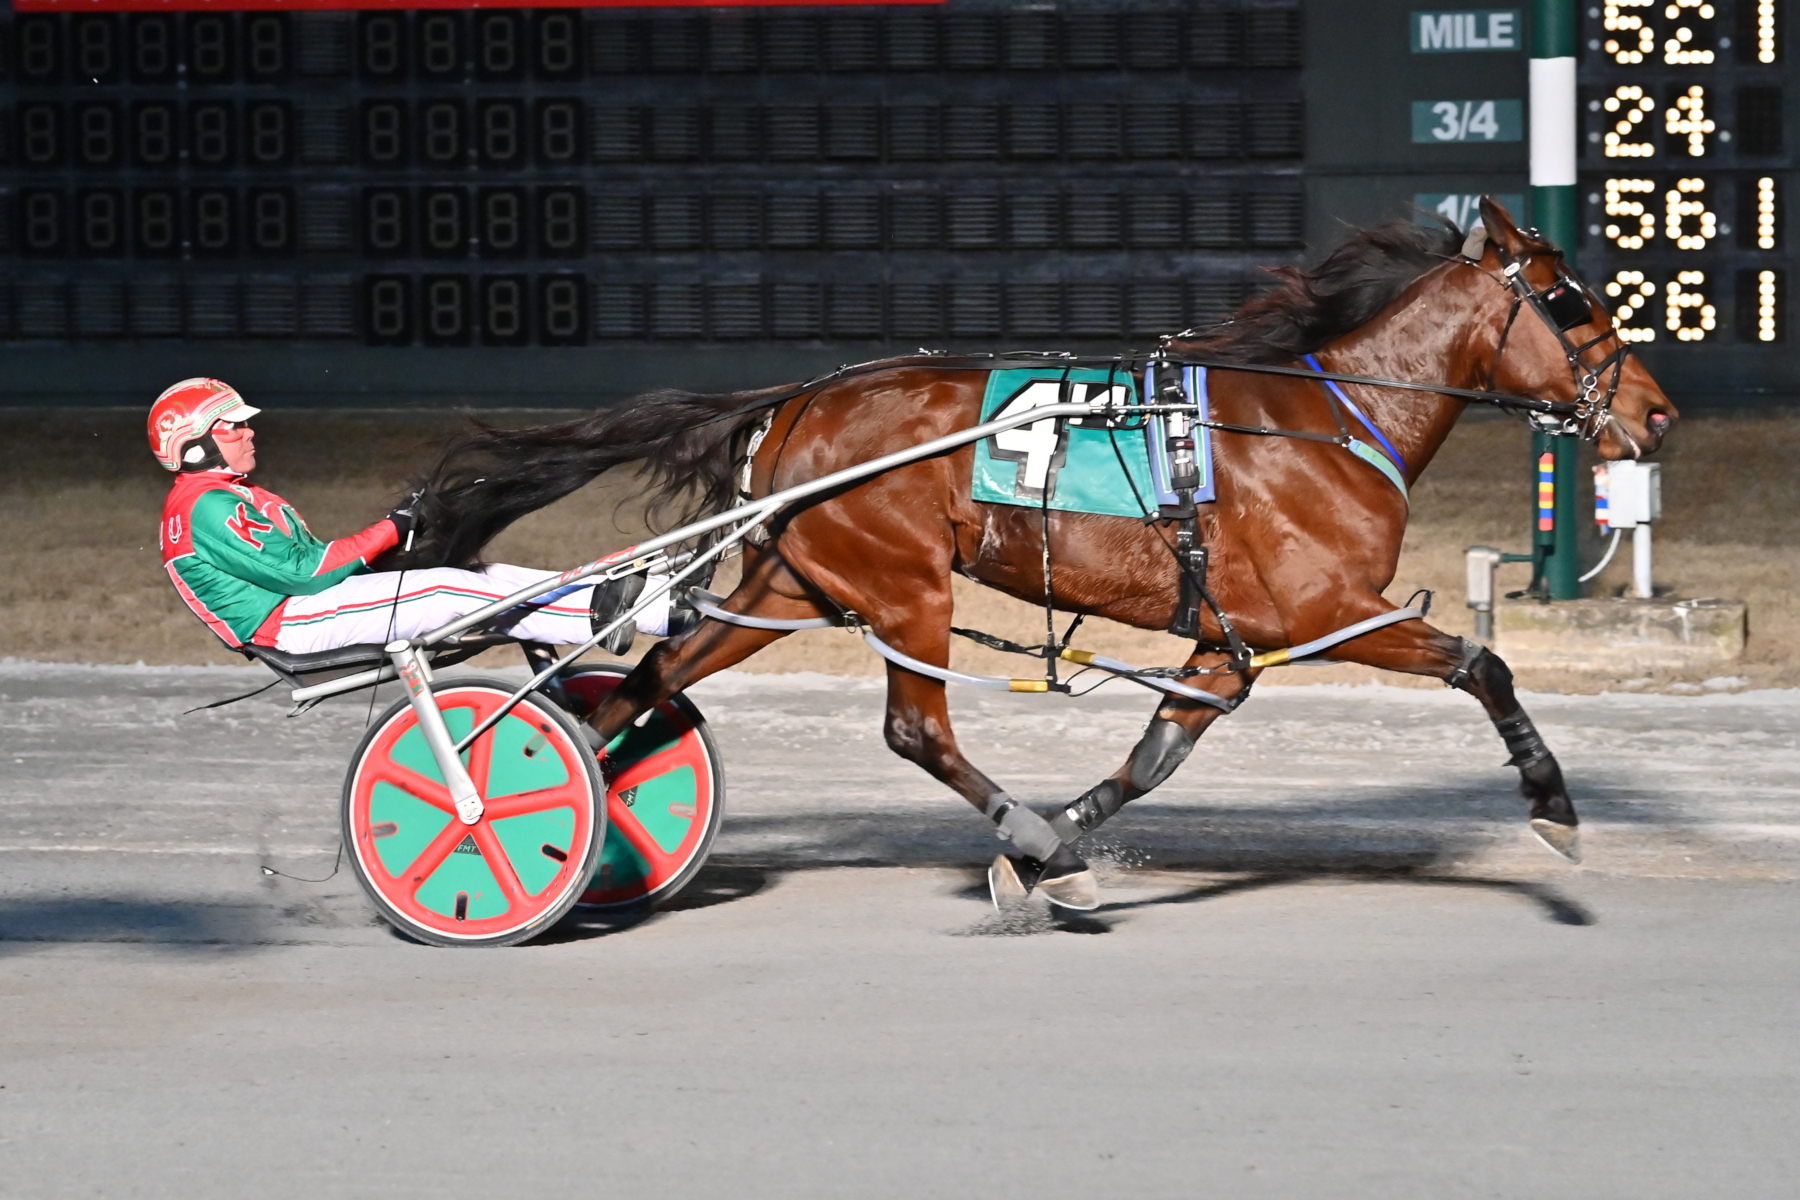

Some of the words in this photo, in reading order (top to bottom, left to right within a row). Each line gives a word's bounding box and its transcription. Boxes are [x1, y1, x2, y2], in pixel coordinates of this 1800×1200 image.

[1419, 12, 1515, 50] MILE
[1431, 101, 1499, 140] 3/4
[1604, 86, 1716, 158] 24
[1605, 177, 1717, 250] 56
[1758, 177, 1775, 250] 1
[1758, 270, 1775, 342] 1
[987, 380, 1062, 490] 4
[225, 502, 273, 551] K
[456, 844, 477, 853] FMT
